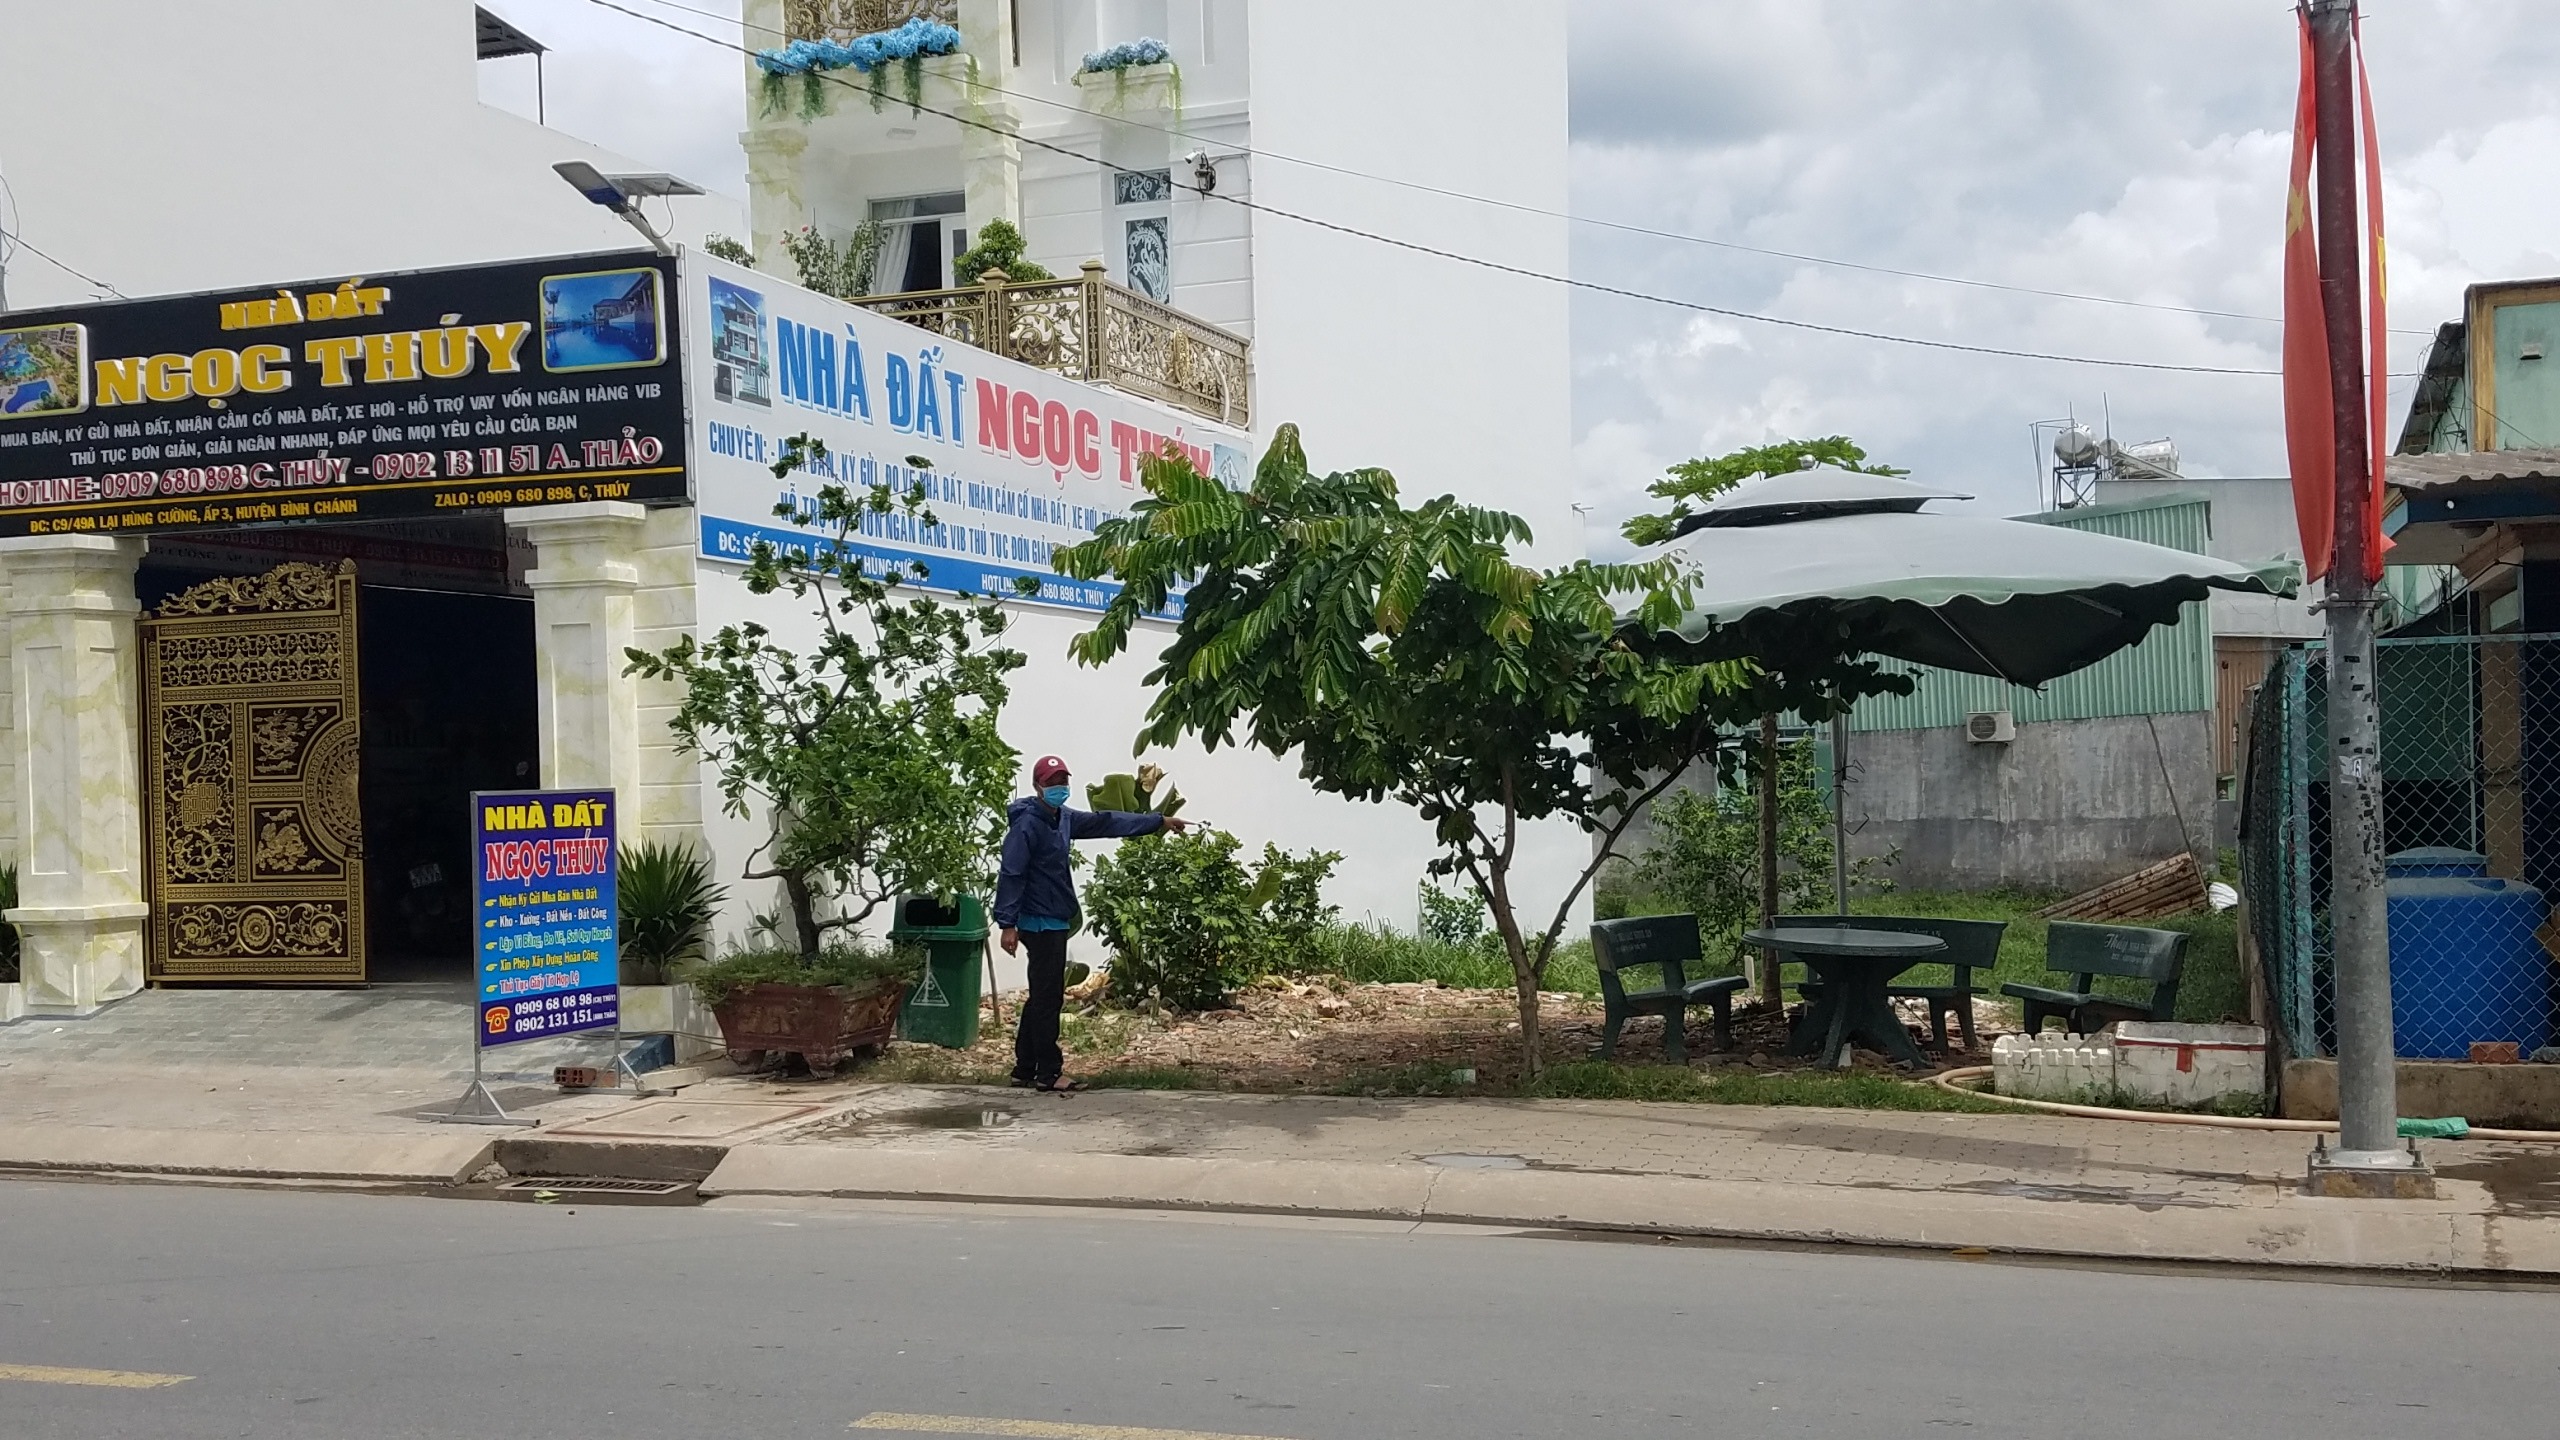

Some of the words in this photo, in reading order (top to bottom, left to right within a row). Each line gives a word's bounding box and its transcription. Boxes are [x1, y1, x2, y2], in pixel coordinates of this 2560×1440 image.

[220, 289, 304, 330] NHÀ
[306, 277, 391, 321] ĐẤT
[95, 344, 291, 410] NGỌC
[304, 313, 532, 387] THÚY
[1, 433, 28, 447] MUA
[31, 428, 62, 446] BÁN,
[65, 425, 83, 442] KÝ
[88, 421, 109, 440] GỬI
[114, 420, 141, 438] NHÀ
[145, 416, 172, 436] ĐẤT,
[176, 416, 212, 434] NHẬN
[218, 410, 248, 429] CẦM
[252, 407, 273, 426] CỐ
[277, 406, 306, 425] NHÀ
[311, 402, 342, 423] ĐẤT,
[345, 405, 365, 420] XE
[370, 401, 395, 418] HƠI
[408, 394, 428, 415] HỖ
[434, 395, 464, 415] TRỢ
[470, 395, 495, 411] VAY
[502, 387, 532, 408] VỐN
[537, 387, 580, 406] NGÂN
[585, 384, 629, 403] HÀNG
[635, 383, 661, 399] VIB
[776, 315, 873, 425] NHÀ
[885, 345, 967, 448] ĐẤT
[975, 377, 1101, 489] NGỌC
[70, 447, 96, 466] THỦ
[100, 449, 127, 465] TỤC
[131, 444, 160, 460] ĐƠN
[165, 439, 201, 459] GIẢN,
[205, 435, 232, 455] GIẢI
[237, 434, 275, 452] NGÂN
[280, 431, 334, 449] NHANH,
[338, 427, 367, 445] ĐÁP
[372, 424, 402, 442] ỨNG
[407, 424, 435, 442] MỌI
[441, 419, 470, 438] YÊU
[475, 414, 505, 435] CẦU
[510, 413, 541, 433] CỦA
[546, 415, 577, 433] BẠN
[0, 476, 101, 507] HOTLINE:
[101, 471, 158, 499] 0909
[160, 467, 205, 494] 680
[204, 464, 249, 491] 898
[372, 451, 437, 480] 0902
[444, 448, 474, 477] 13
[479, 447, 503, 474] 11
[509, 444, 540, 472] 51
[477, 489, 512, 504] 0909
[516, 487, 543, 502] 680
[594, 480, 631, 497] THÚY
[709, 421, 768, 464] CHUYÊN:
[841, 449, 856, 483] KÝ
[943, 471, 965, 510] ĐẤT,
[969, 480, 993, 516] NHẬN
[1018, 488, 1029, 519] CỐ
[1031, 494, 1048, 523] NHÀ
[1051, 496, 1070, 531] ĐẤT,
[1072, 505, 1083, 529] XE
[30, 520, 50, 533] ĐC:
[52, 516, 96, 531] C9/49A
[99, 514, 118, 531] LẠI
[122, 510, 153, 527] HÙNG
[157, 507, 201, 524] CƯỜNG,
[236, 502, 276, 520] HUYỆN
[280, 501, 309, 517] BÌNH
[314, 497, 357, 514] CHÁNH
[886, 511, 916, 543] NGÂN
[950, 524, 966, 552] VIB
[969, 523, 986, 556] THỦ
[990, 532, 1008, 563] TỤC
[1011, 534, 1029, 563] ĐƠN
[719, 531, 740, 554] ĐC:
[1043, 583, 1058, 599] 680
[1060, 585, 1074, 602] 898
[1084, 586, 1104, 606] THÚY
[484, 800, 547, 831] NHÀ
[553, 798, 607, 828] ĐẤT
[485, 840, 551, 886] NGỌC
[553, 828, 608, 876] THÚY
[499, 915, 513, 928] Kho
[515, 1000, 543, 1015] 0909
[546, 997, 560, 1011] 68
[562, 995, 576, 1008] 08
[578, 993, 592, 1006] 98
[515, 1015, 544, 1033] 0902
[548, 1012, 568, 1028] 131
[572, 1009, 592, 1024] 151
